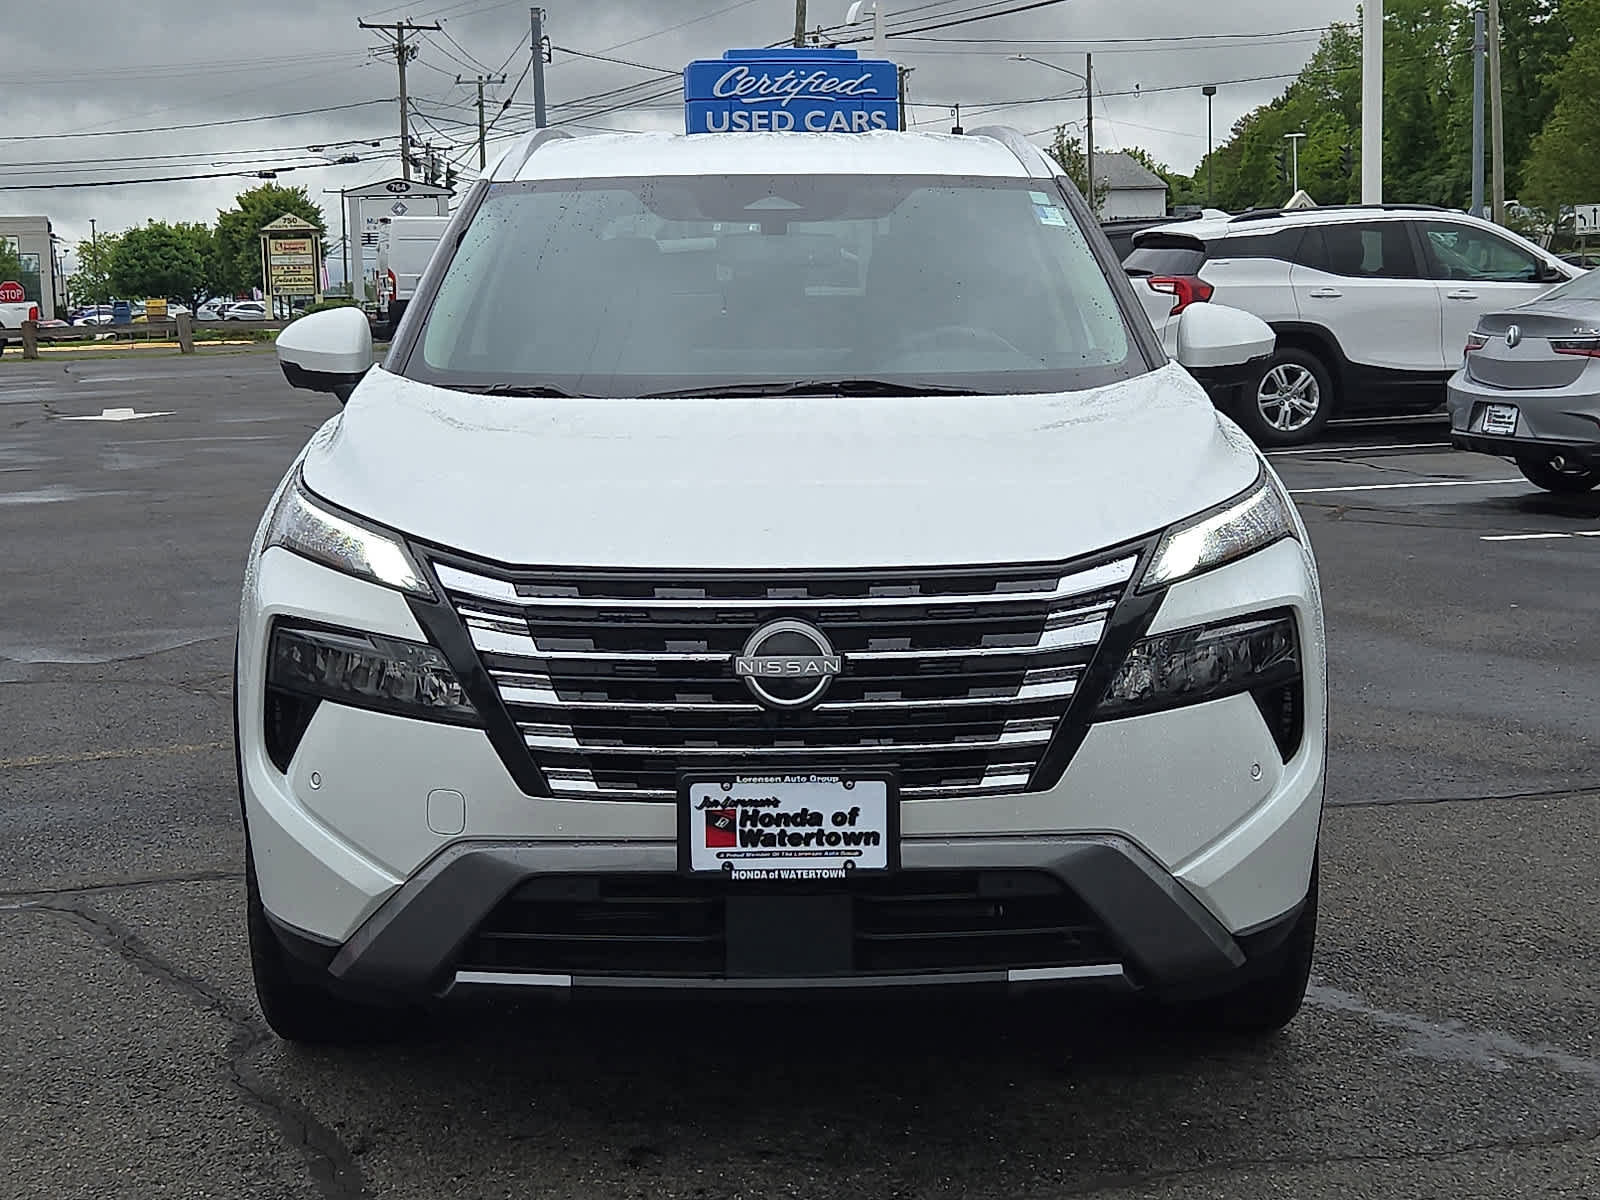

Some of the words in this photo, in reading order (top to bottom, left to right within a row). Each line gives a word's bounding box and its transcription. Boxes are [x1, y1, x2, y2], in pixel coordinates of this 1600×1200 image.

[713, 66, 878, 107] Certified
[706, 111, 795, 132] USED
[804, 111, 888, 132] CARS
[0, 289, 22, 300] STOP
[739, 660, 839, 673] NISSAN
[736, 775, 782, 783] Lorensen
[784, 775, 807, 783] Auto
[810, 775, 840, 784] Group
[738, 807, 824, 828] Honda
[831, 807, 861, 827] of
[738, 828, 881, 848] Watertown
[731, 870, 768, 880] HONDA
[769, 870, 779, 879] of
[781, 869, 846, 879] WATERTOWN
